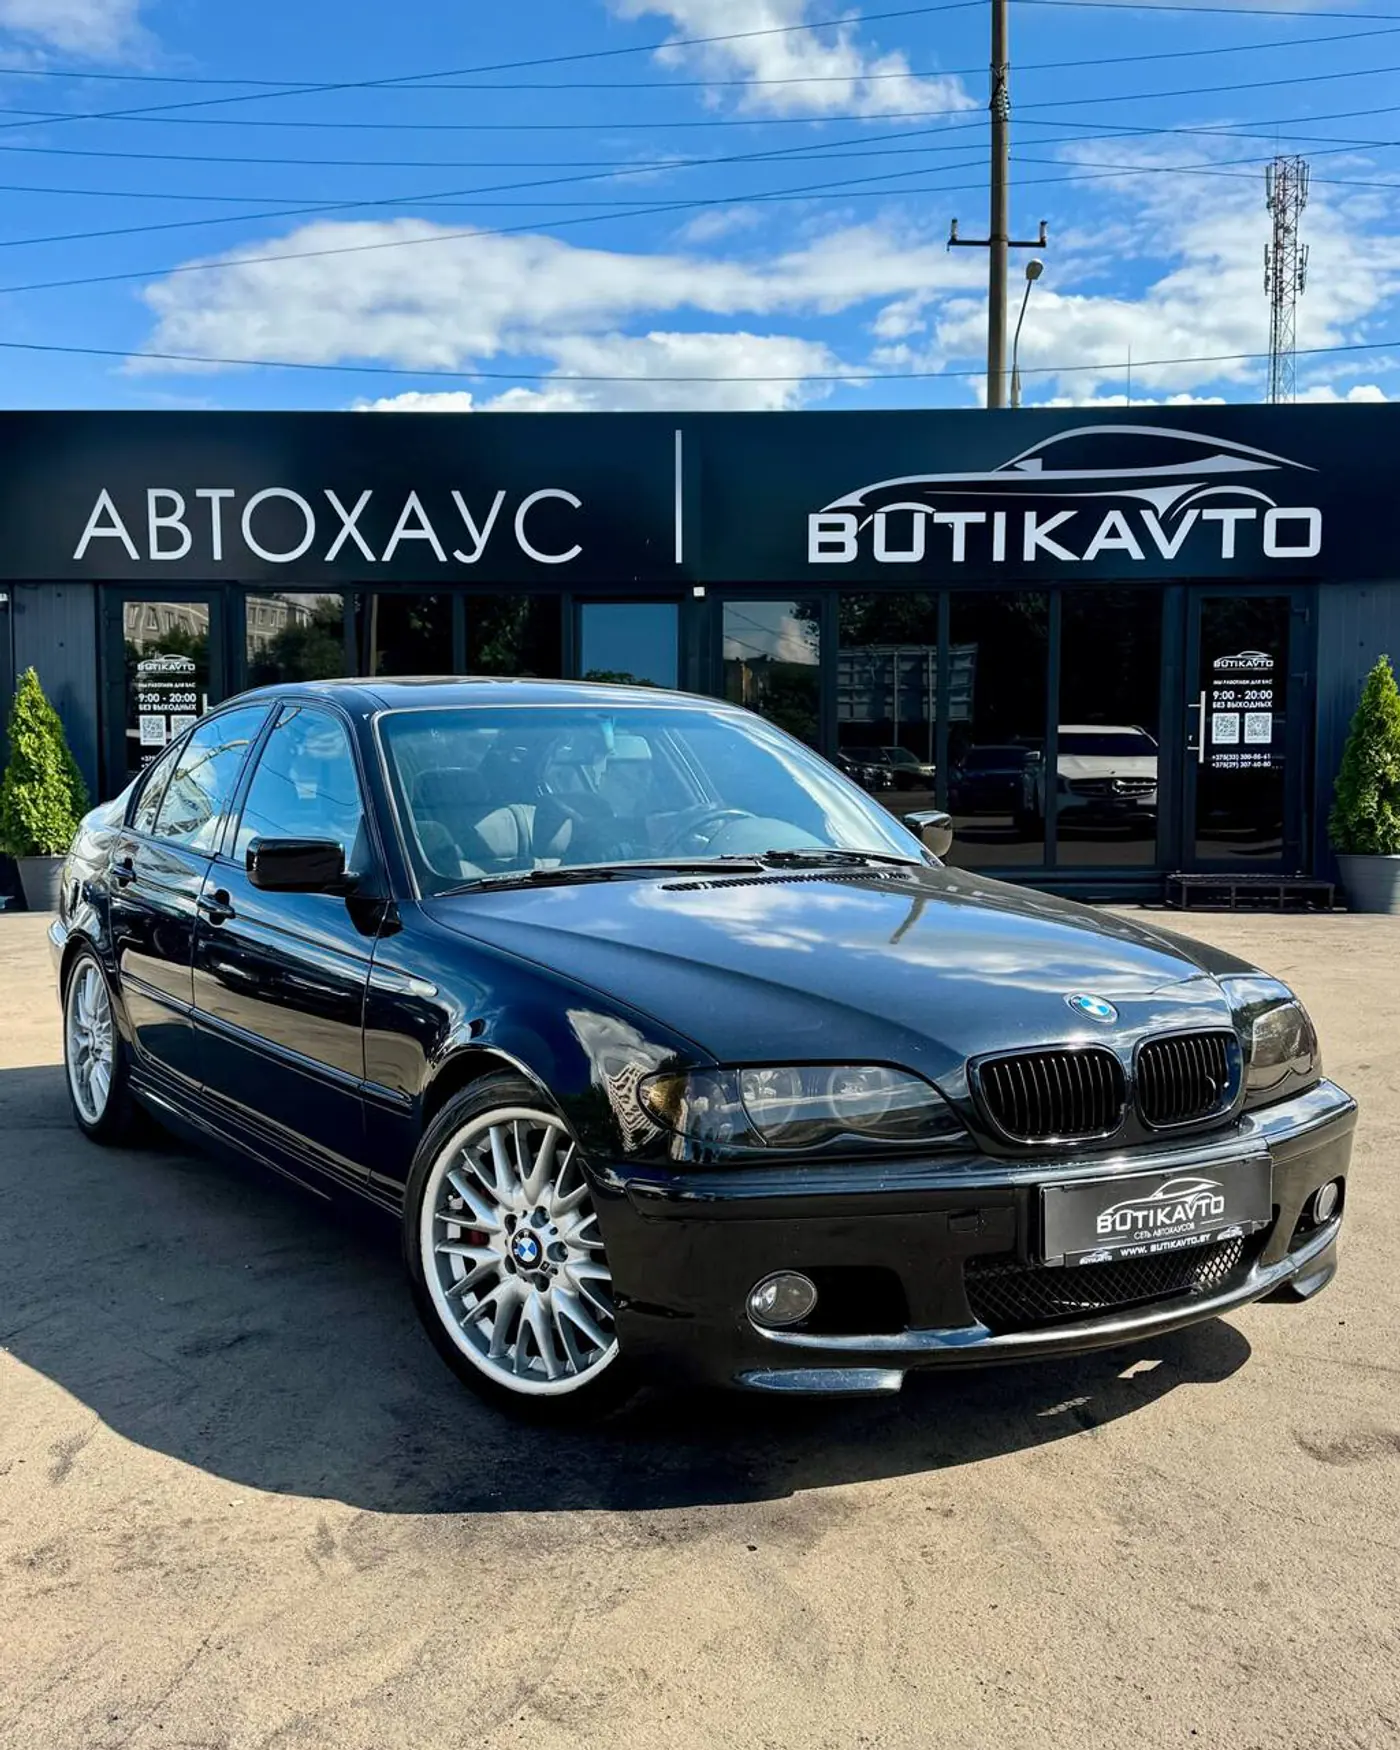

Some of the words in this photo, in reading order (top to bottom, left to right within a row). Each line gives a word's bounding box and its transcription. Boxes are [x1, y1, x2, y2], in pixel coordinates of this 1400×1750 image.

[73, 487, 584, 564] АВТОХАУС
[808, 507, 1323, 563] BUTIKAVTO
[1213, 660, 1274, 668] BUTIKAVTO
[138, 693, 160, 702] 9:00
[169, 693, 197, 702] 20:00
[1212, 690, 1235, 700] 9:00
[1244, 689, 1273, 700] 20:00
[1096, 1195, 1225, 1234] BUTIKAVTO
[1133, 1230, 1152, 1241] СЕТЬ
[1153, 1222, 1195, 1237] АВТОХАУСОВ
[1150, 1233, 1211, 1252] BUTIKAVTO.BY
